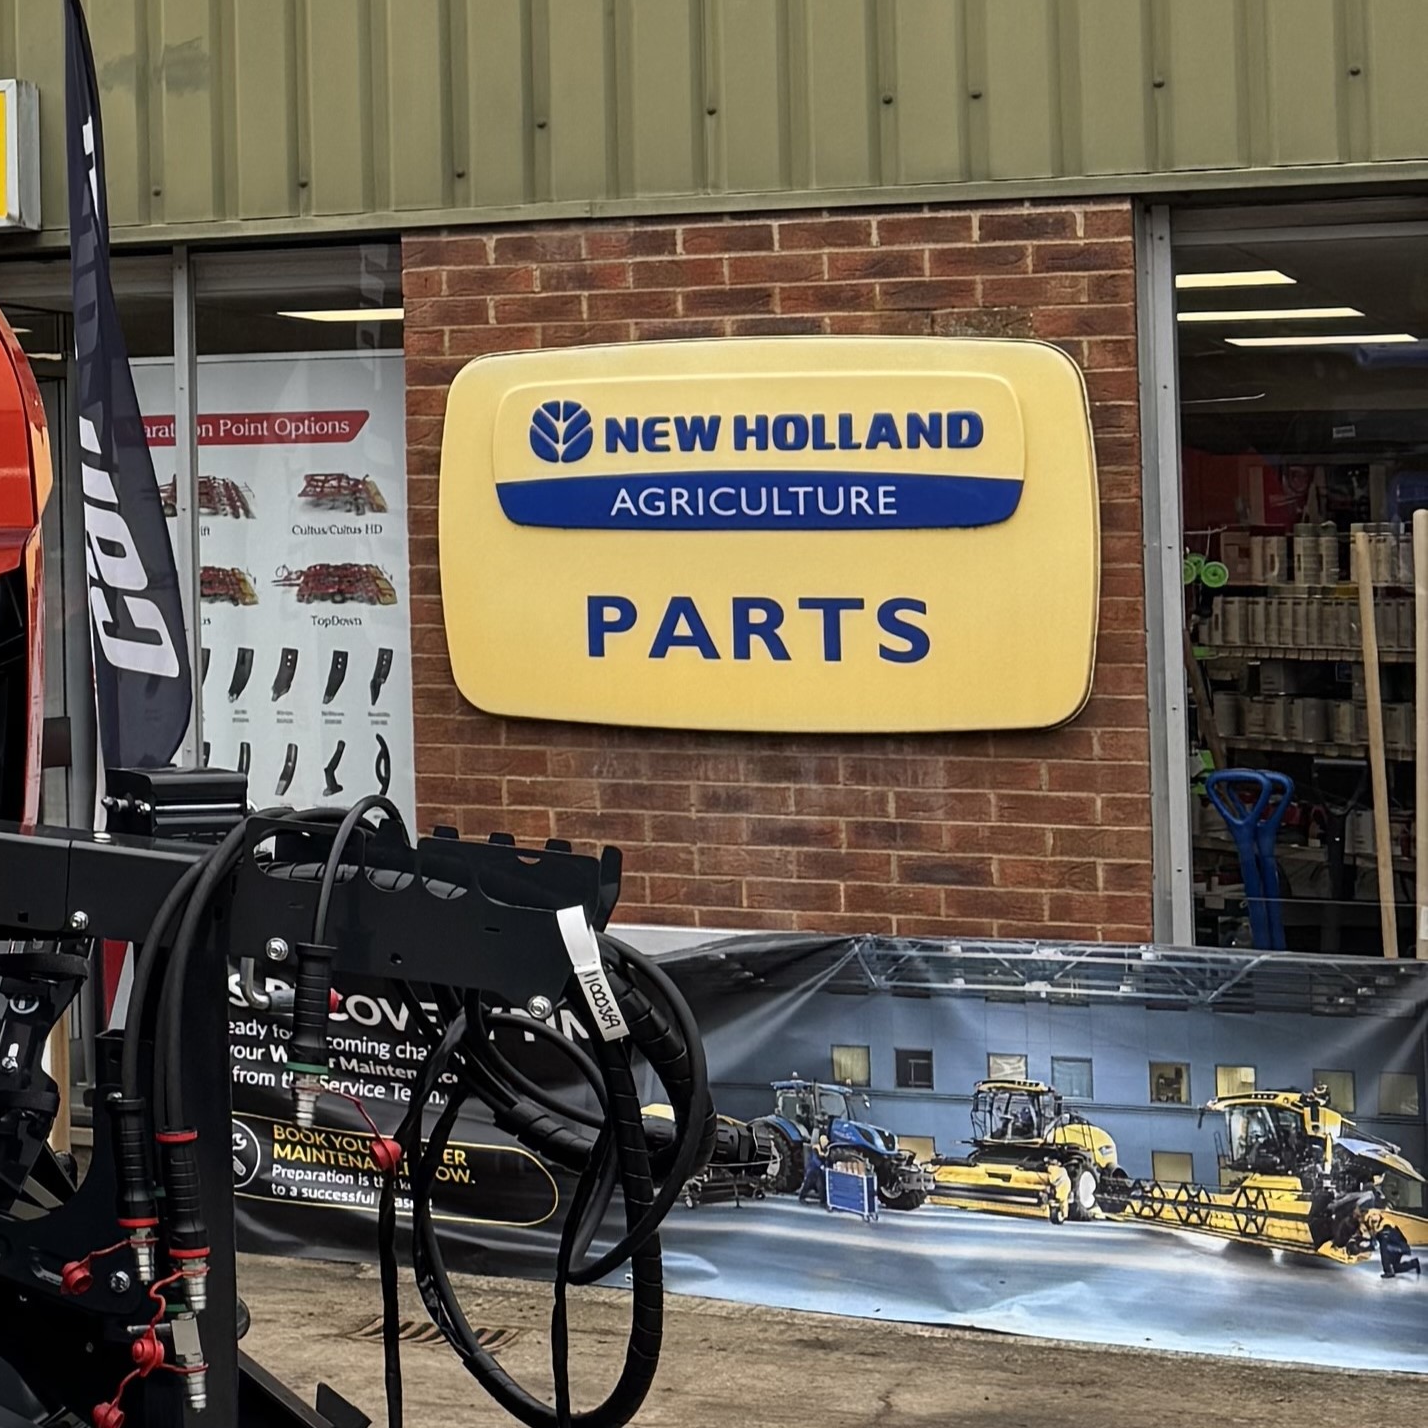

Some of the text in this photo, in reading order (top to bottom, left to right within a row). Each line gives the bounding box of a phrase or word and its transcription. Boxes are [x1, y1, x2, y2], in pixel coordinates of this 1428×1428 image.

[219, 419, 269, 437] Point
[274, 416, 350, 440] Options
[604, 409, 984, 453] NEW HOLLAND
[610, 484, 898, 517] AGRICULTURE
[364, 524, 383, 535] HD
[311, 615, 363, 628] TopDown
[586, 595, 931, 663] PARTS
[232, 1065, 276, 1087] from
[319, 1075, 386, 1099] Service
[273, 1124, 327, 1148] BOOK
[271, 1164, 354, 1187] Preparation
[358, 1173, 370, 1187] is
[271, 1183, 375, 1205] to a successful
